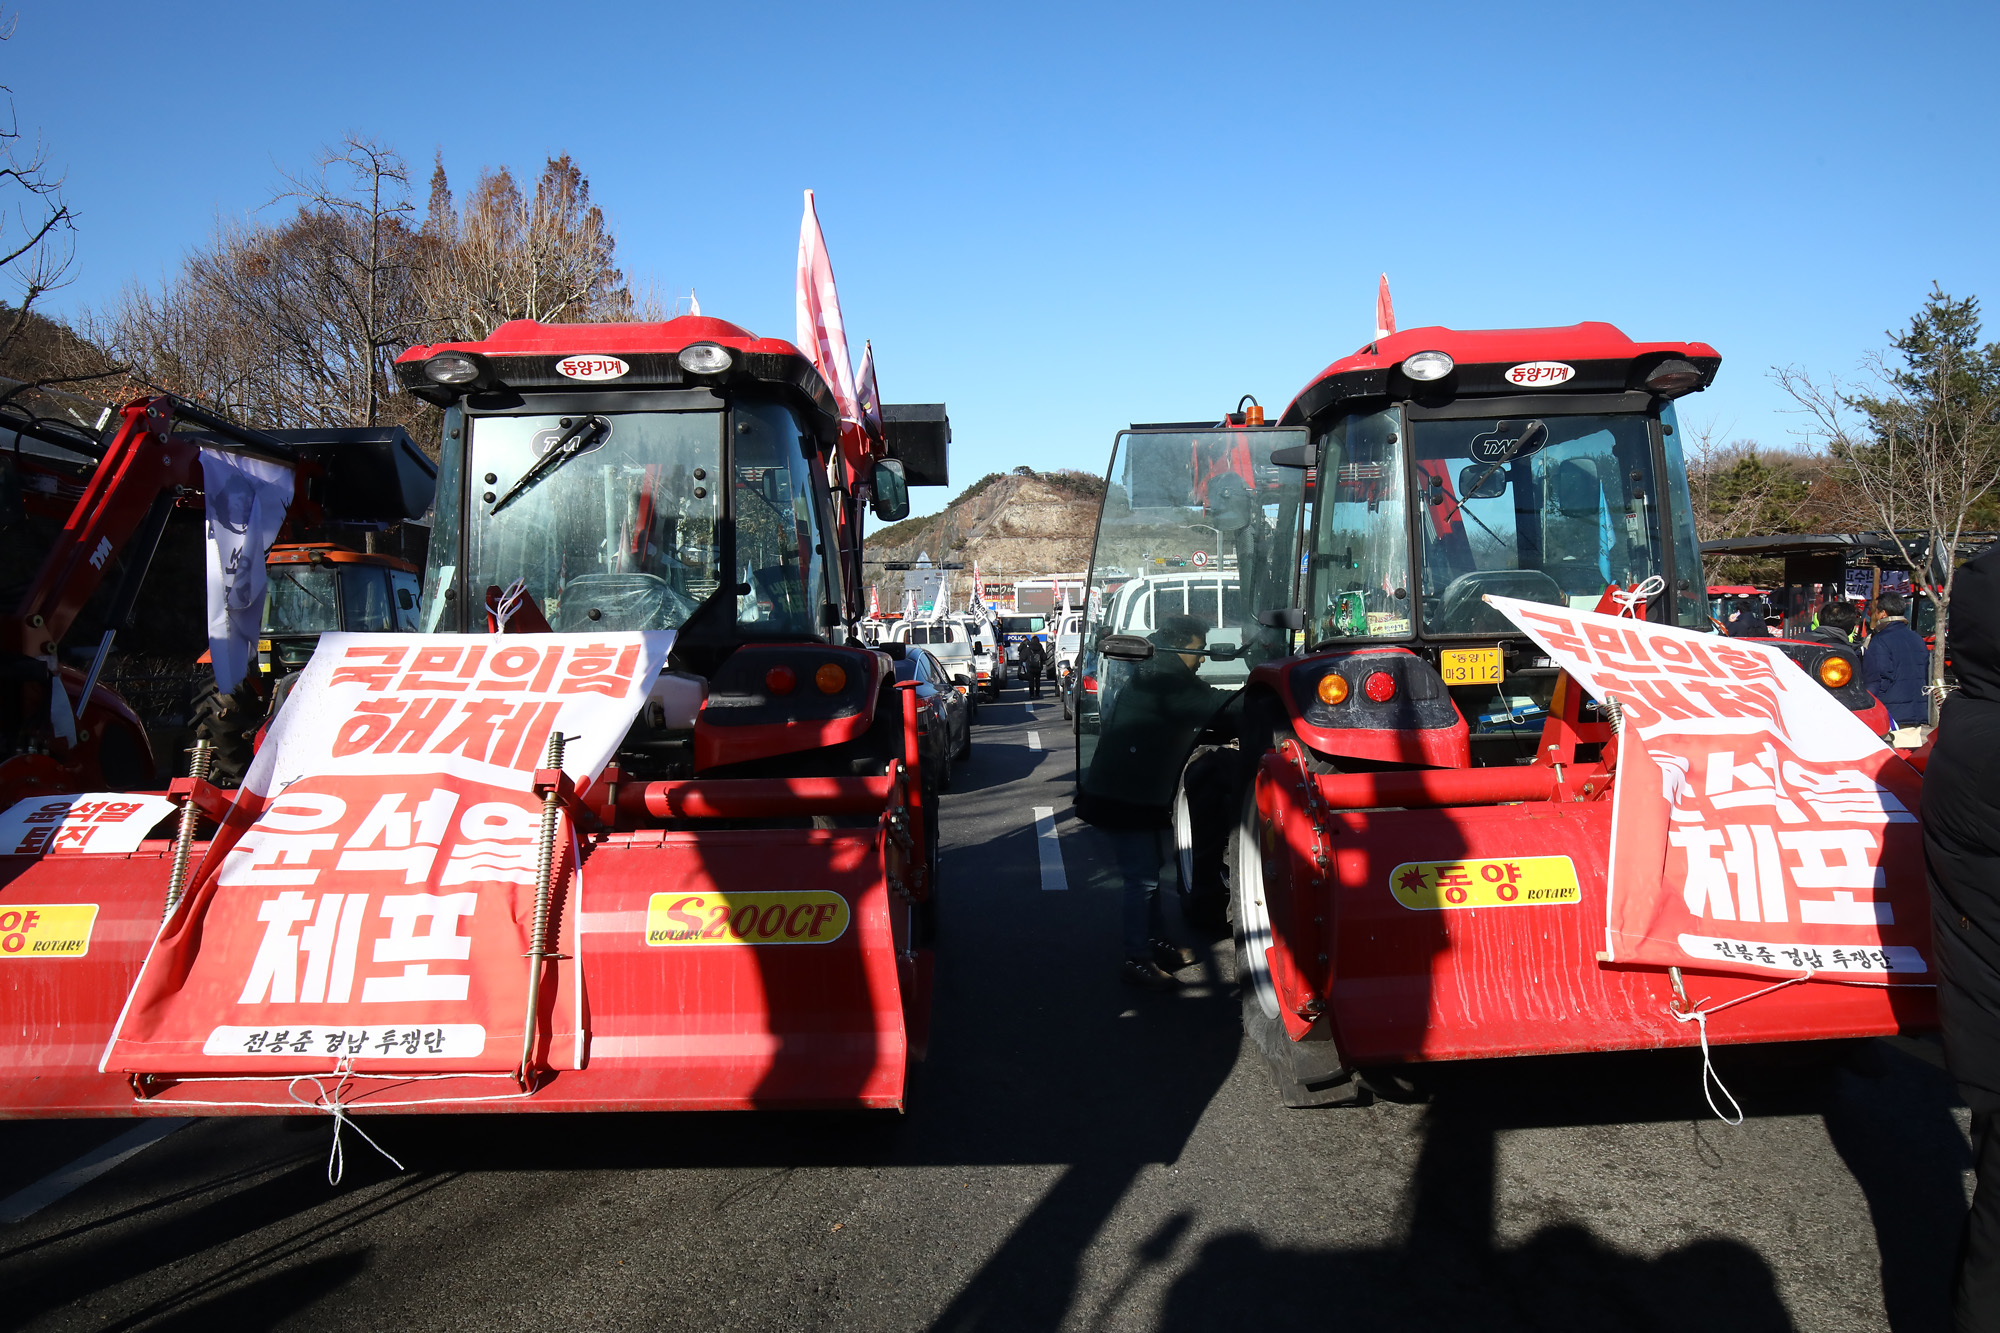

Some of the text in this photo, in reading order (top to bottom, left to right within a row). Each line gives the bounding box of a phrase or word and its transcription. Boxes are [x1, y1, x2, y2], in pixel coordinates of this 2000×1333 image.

[562, 360, 623, 376] 동양기계
[1511, 366, 1569, 383] 동양기계
[543, 435, 581, 453] TM
[328, 642, 643, 700] 국민의힘
[331, 697, 564, 773] 해체
[22, 800, 144, 824] 윤석열
[14, 825, 100, 854] 퇴진
[216, 787, 542, 887] 윤석열
[1434, 863, 1523, 905] 동양
[1667, 823, 1895, 926] 체포
[1527, 887, 1576, 900] ROTARY
[666, 896, 840, 940] S200CF
[32, 939, 85, 952] ROTARY
[237, 890, 478, 1005] 체포
[649, 929, 704, 942] ROTARY
[1712, 940, 1894, 970] 전봉준 경남 투쟁단
[243, 1028, 446, 1055] 전봉준 경남 투쟁단
